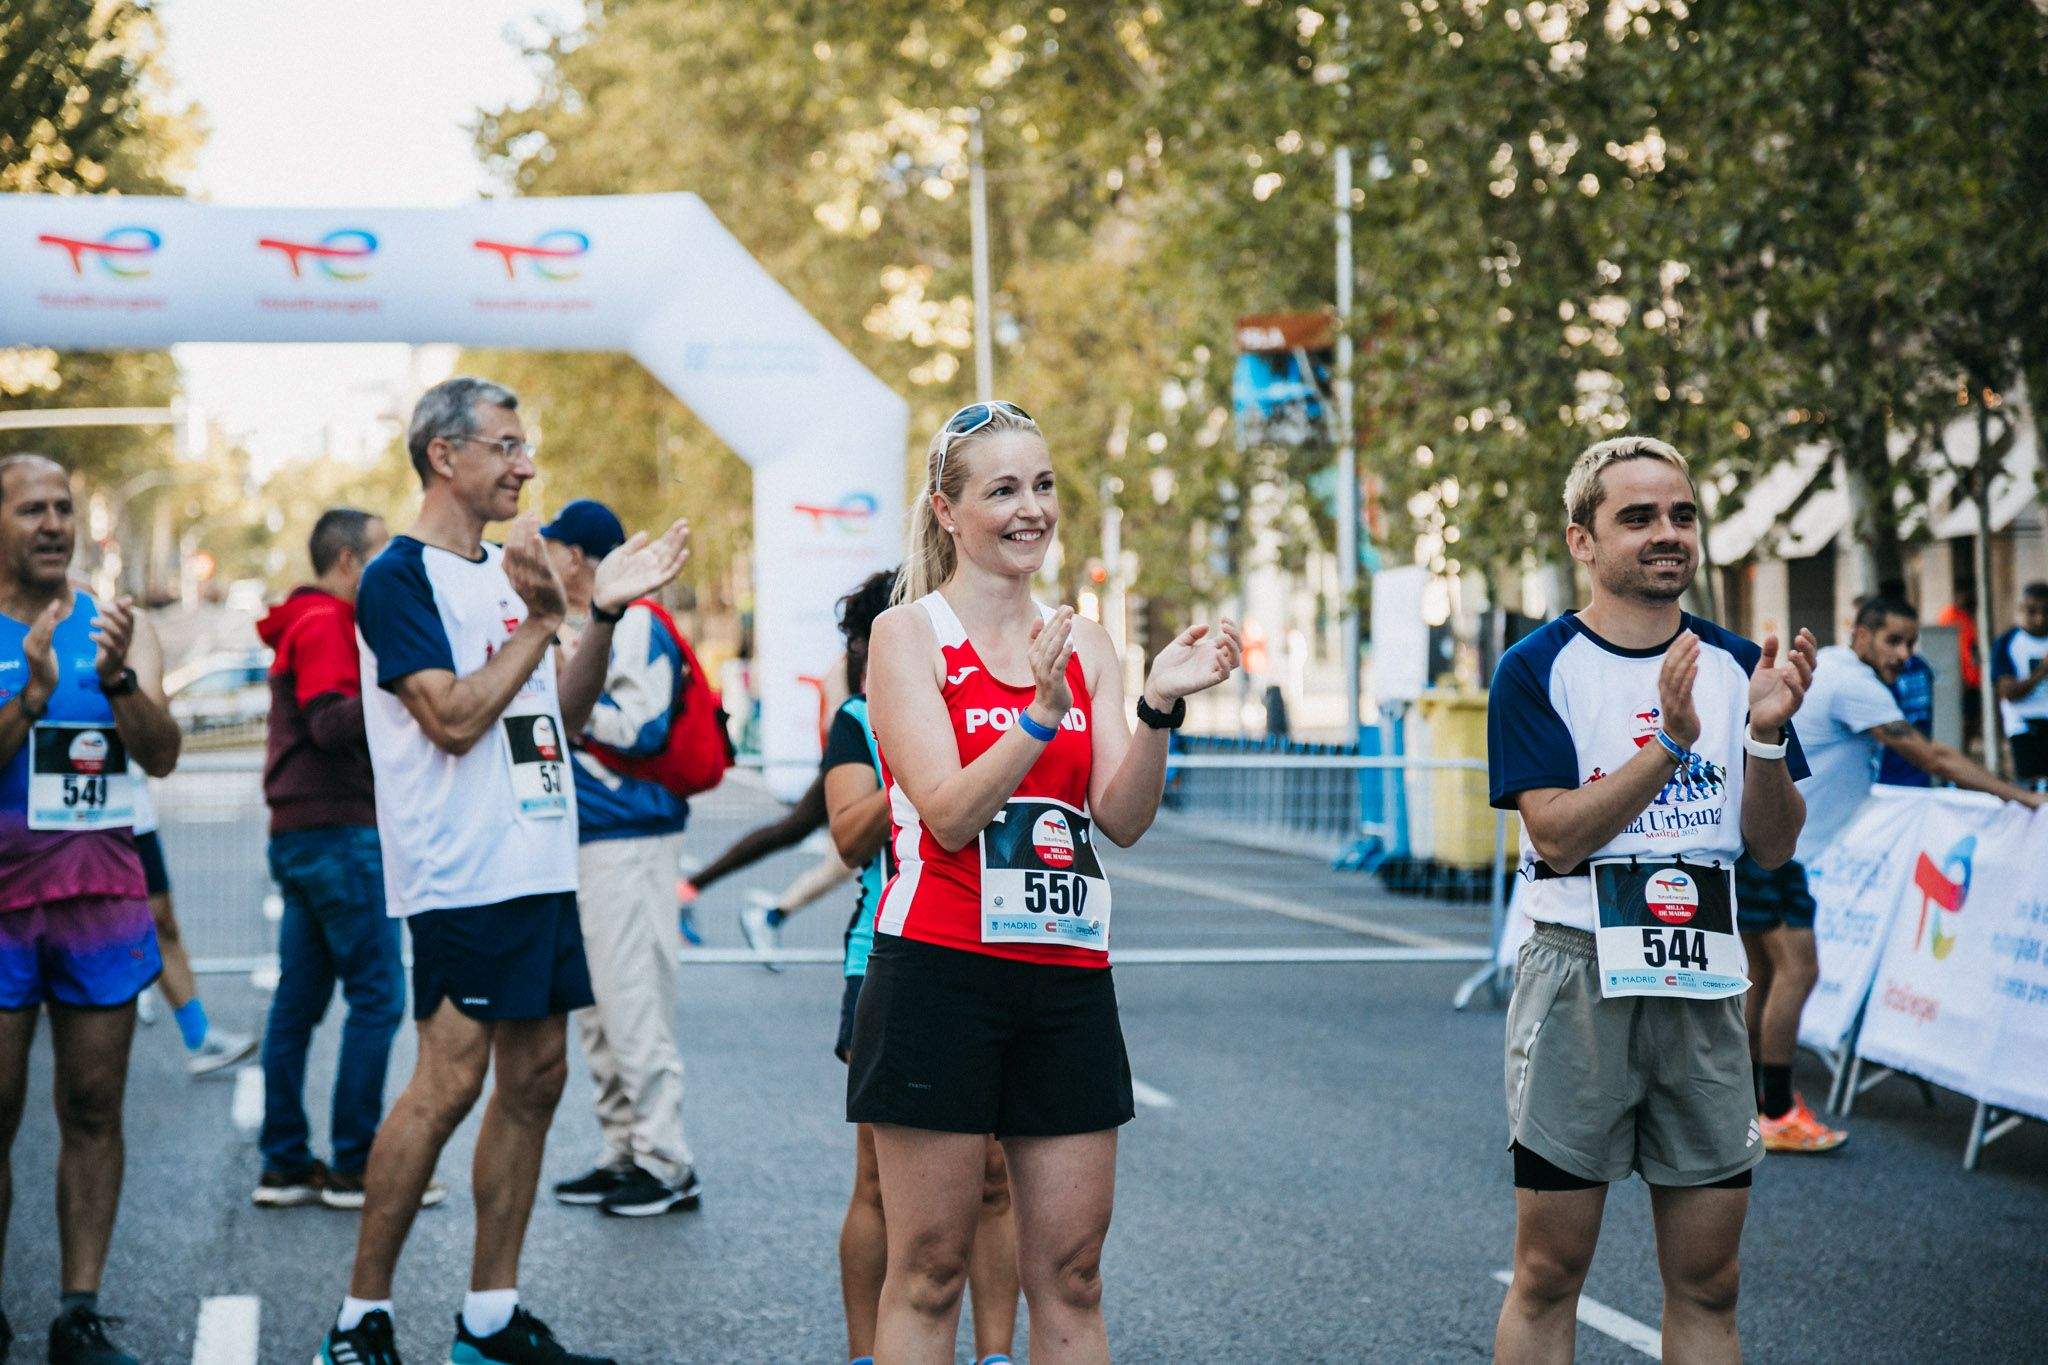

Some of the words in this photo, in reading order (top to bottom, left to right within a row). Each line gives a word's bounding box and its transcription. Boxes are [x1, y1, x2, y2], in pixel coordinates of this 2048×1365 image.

[1648, 806, 1722, 831] Urbana
[1645, 829, 1680, 840] Madrid
[1024, 871, 1088, 917] 550
[1003, 921, 1038, 931] MADRID
[1641, 928, 1709, 971] 544
[1622, 976, 1657, 984] MADRID
